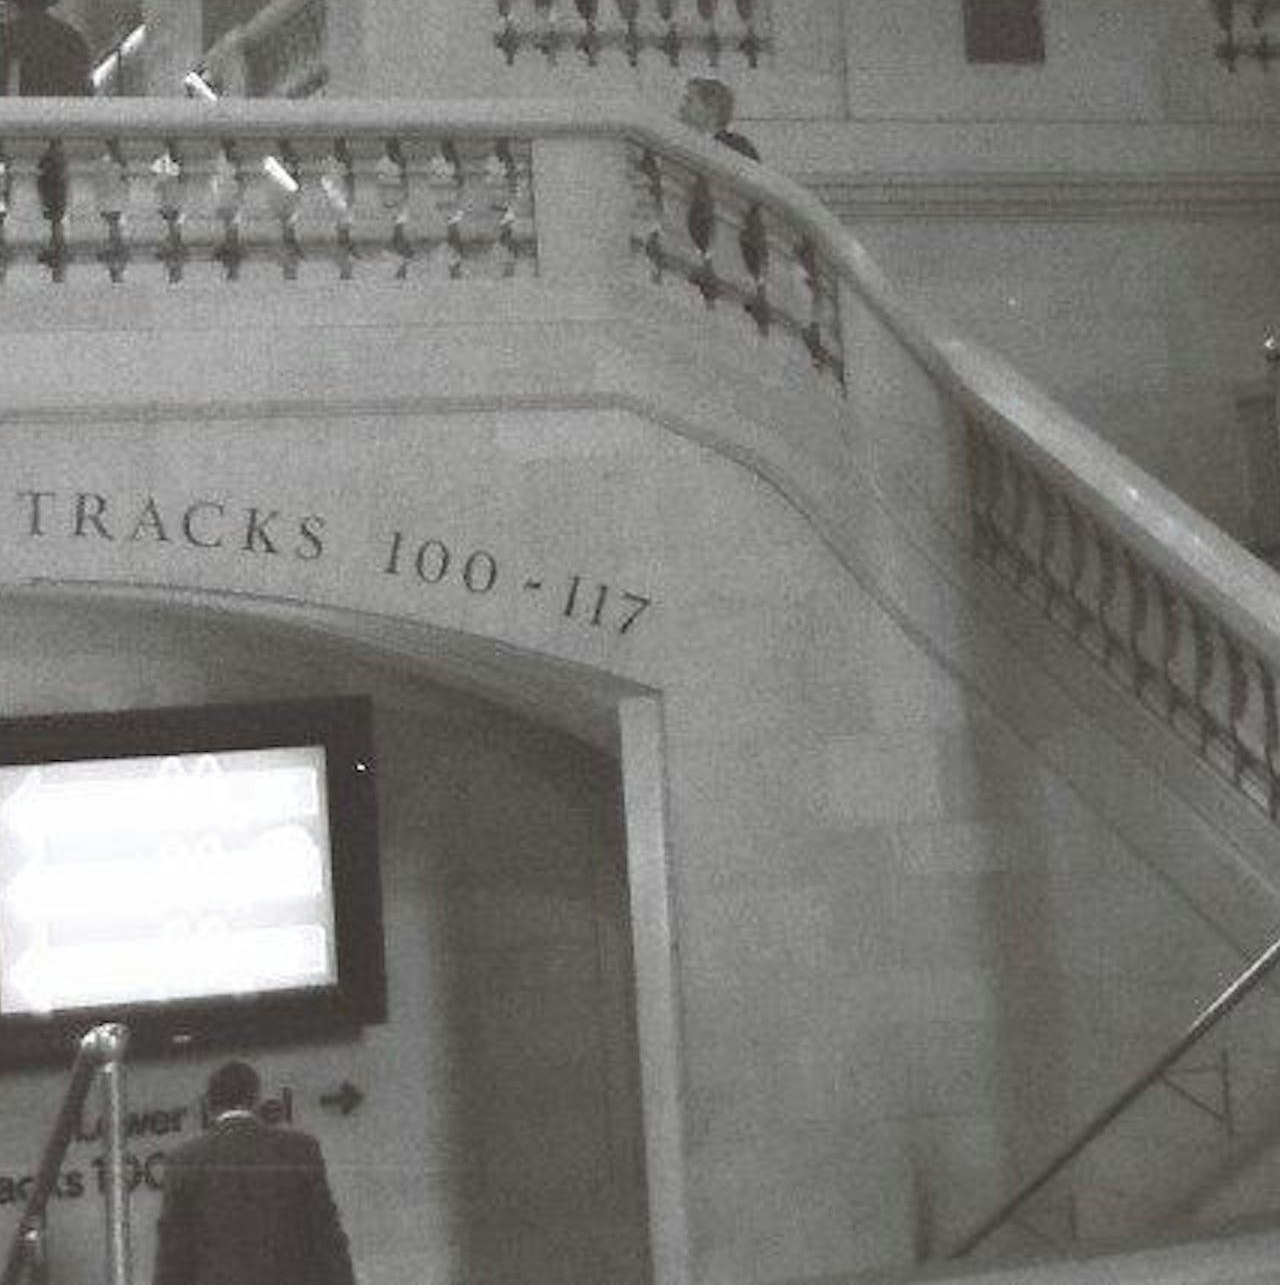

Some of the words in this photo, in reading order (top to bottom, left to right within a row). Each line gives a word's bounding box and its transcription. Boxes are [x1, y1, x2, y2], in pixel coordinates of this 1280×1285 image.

[16, 489, 328, 561] TRACKS
[383, 531, 498, 594] 100
[563, 575, 653, 635] 117
